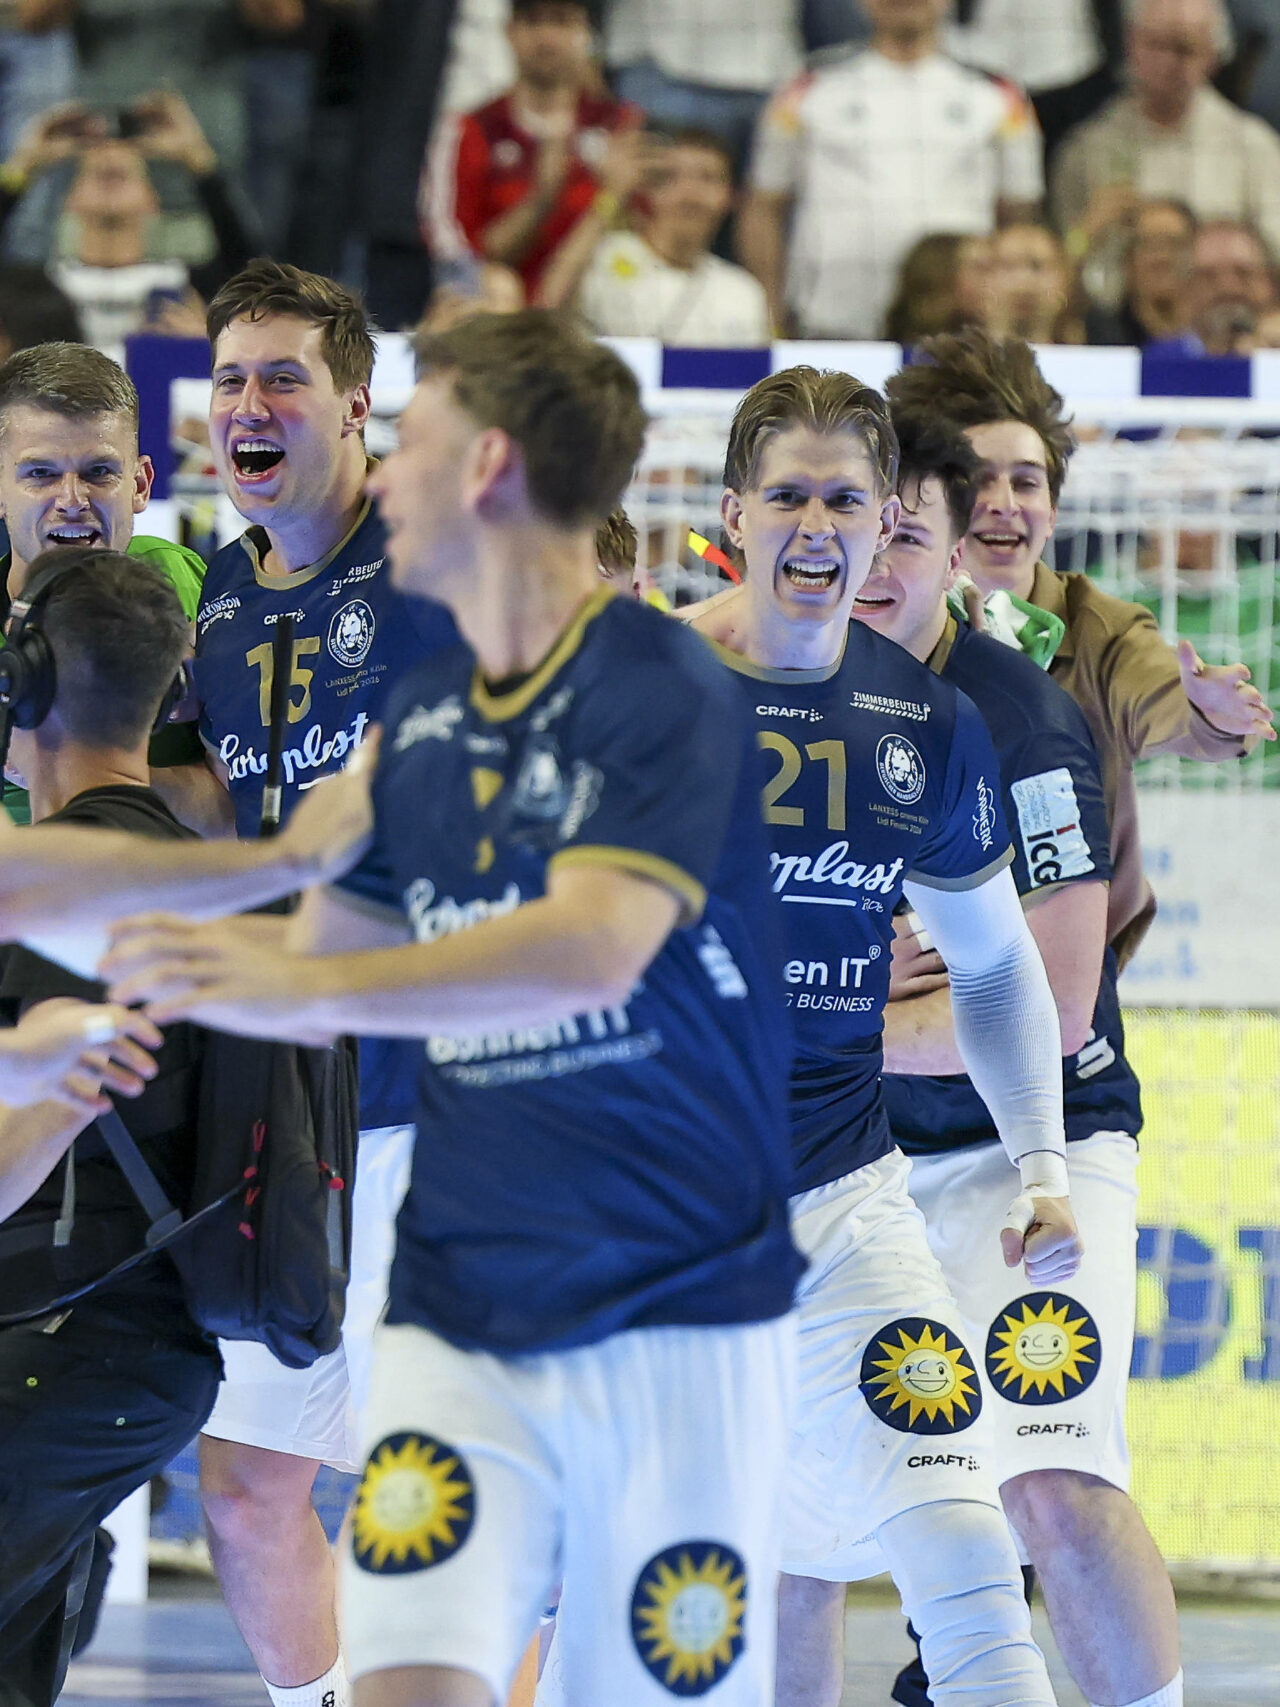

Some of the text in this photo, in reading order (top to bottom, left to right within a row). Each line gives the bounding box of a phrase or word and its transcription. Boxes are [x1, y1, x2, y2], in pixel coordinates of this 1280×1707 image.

[263, 611, 298, 626] CRT
[245, 635, 321, 727] 15
[755, 705, 810, 720] CRAFT
[852, 691, 924, 715] ZIMMERBEUTEL
[756, 730, 847, 831] 21
[976, 775, 994, 852] VORWERK
[783, 958, 829, 987] en
[796, 992, 875, 1013] BUSINESS
[1016, 1424, 1076, 1437] CRAFT
[906, 1454, 967, 1469] CRAFT
